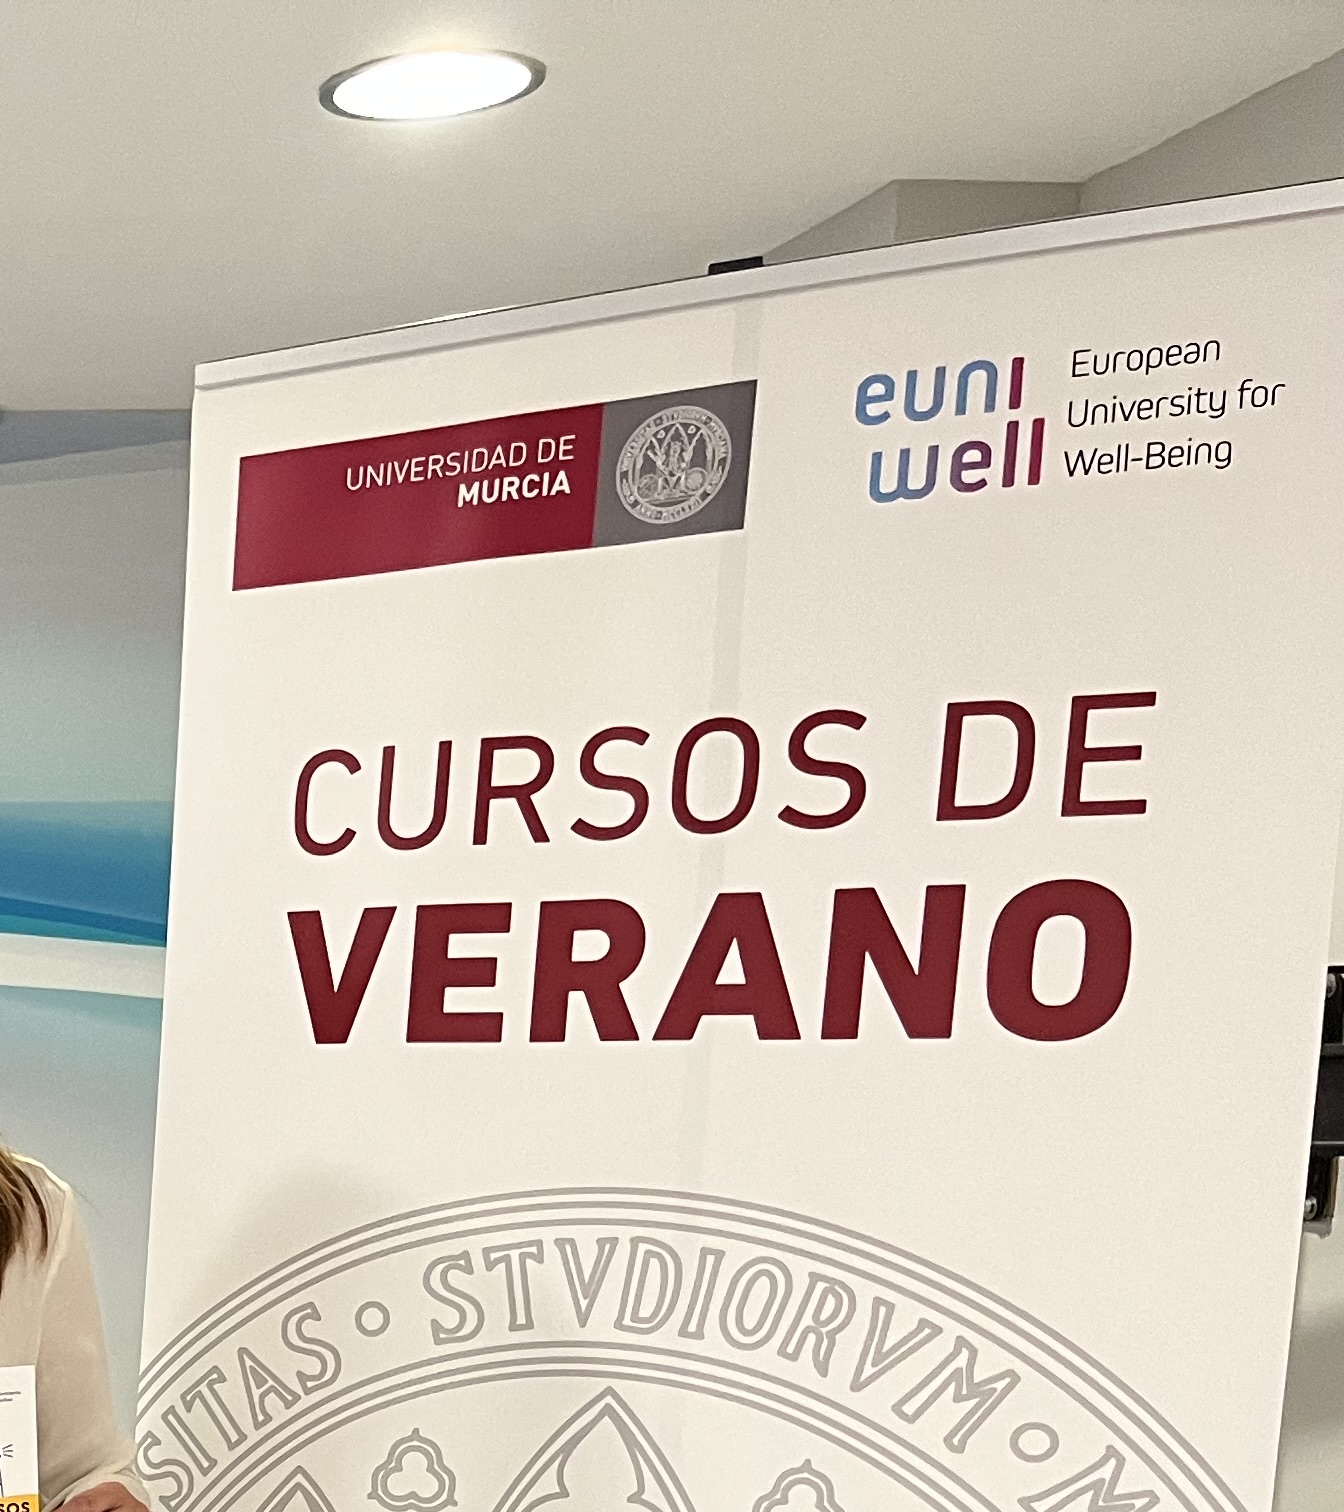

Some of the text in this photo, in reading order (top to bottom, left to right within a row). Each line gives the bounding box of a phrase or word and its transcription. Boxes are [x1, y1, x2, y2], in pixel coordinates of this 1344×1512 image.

[1071, 339, 1221, 379] European
[1066, 378, 1287, 429] University for
[346, 434, 577, 491] UNIVERSIDAD DE
[867, 416, 1046, 504] well
[1063, 437, 1233, 478] Well-Being
[457, 470, 572, 508] MURCIA
[292, 690, 1160, 858] CURSOS DE
[286, 878, 1134, 1045] VERANO
